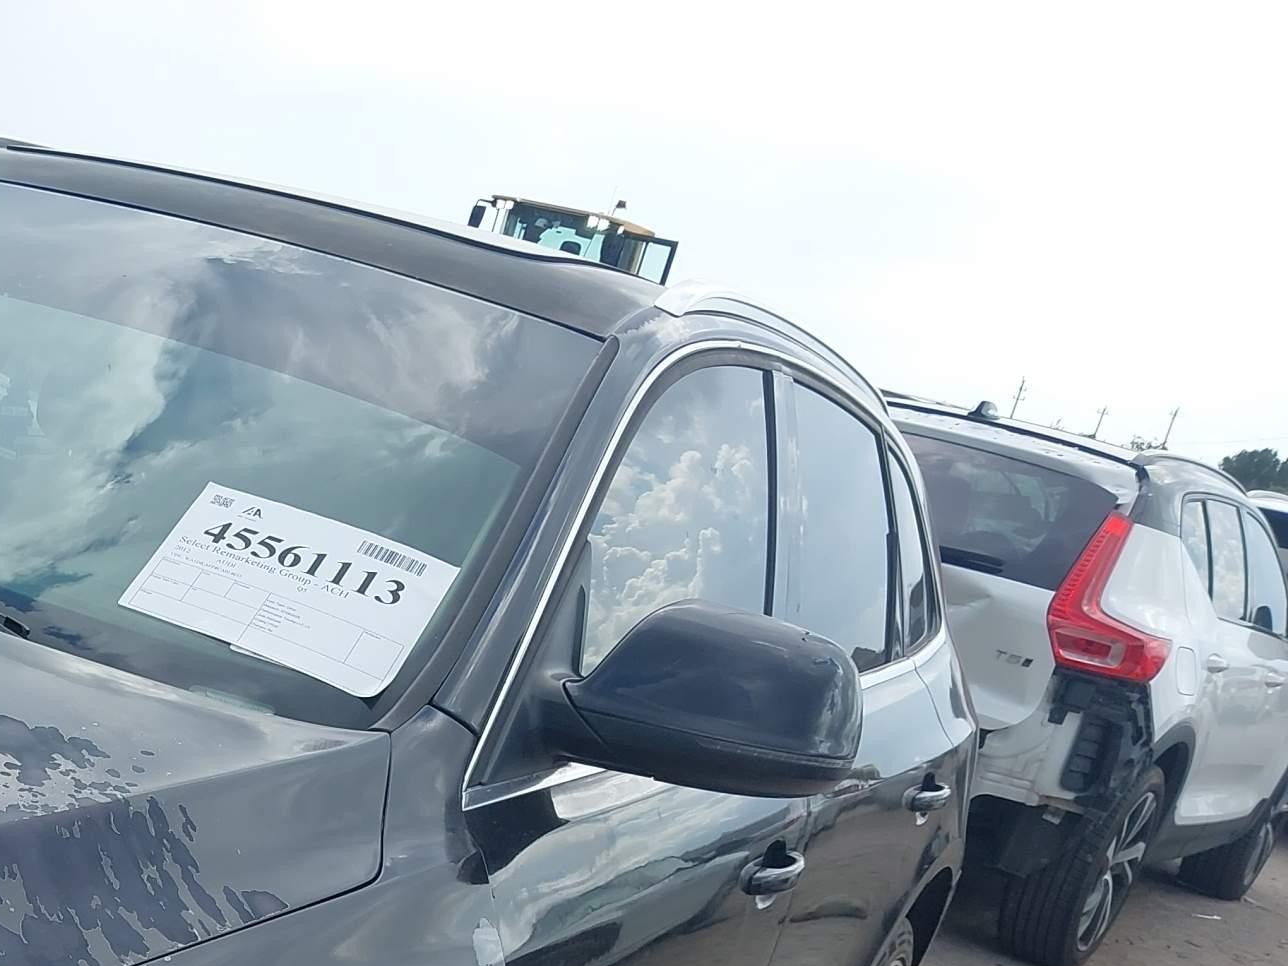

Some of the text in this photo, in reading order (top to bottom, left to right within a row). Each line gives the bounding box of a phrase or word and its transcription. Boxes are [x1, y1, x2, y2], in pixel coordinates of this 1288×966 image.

[179, 535, 210, 551] Select
[212, 543, 276, 575] Remarketing
[279, 568, 311, 587] Group
[321, 583, 350, 599] ACH
[203, 521, 406, 605] 45561113
